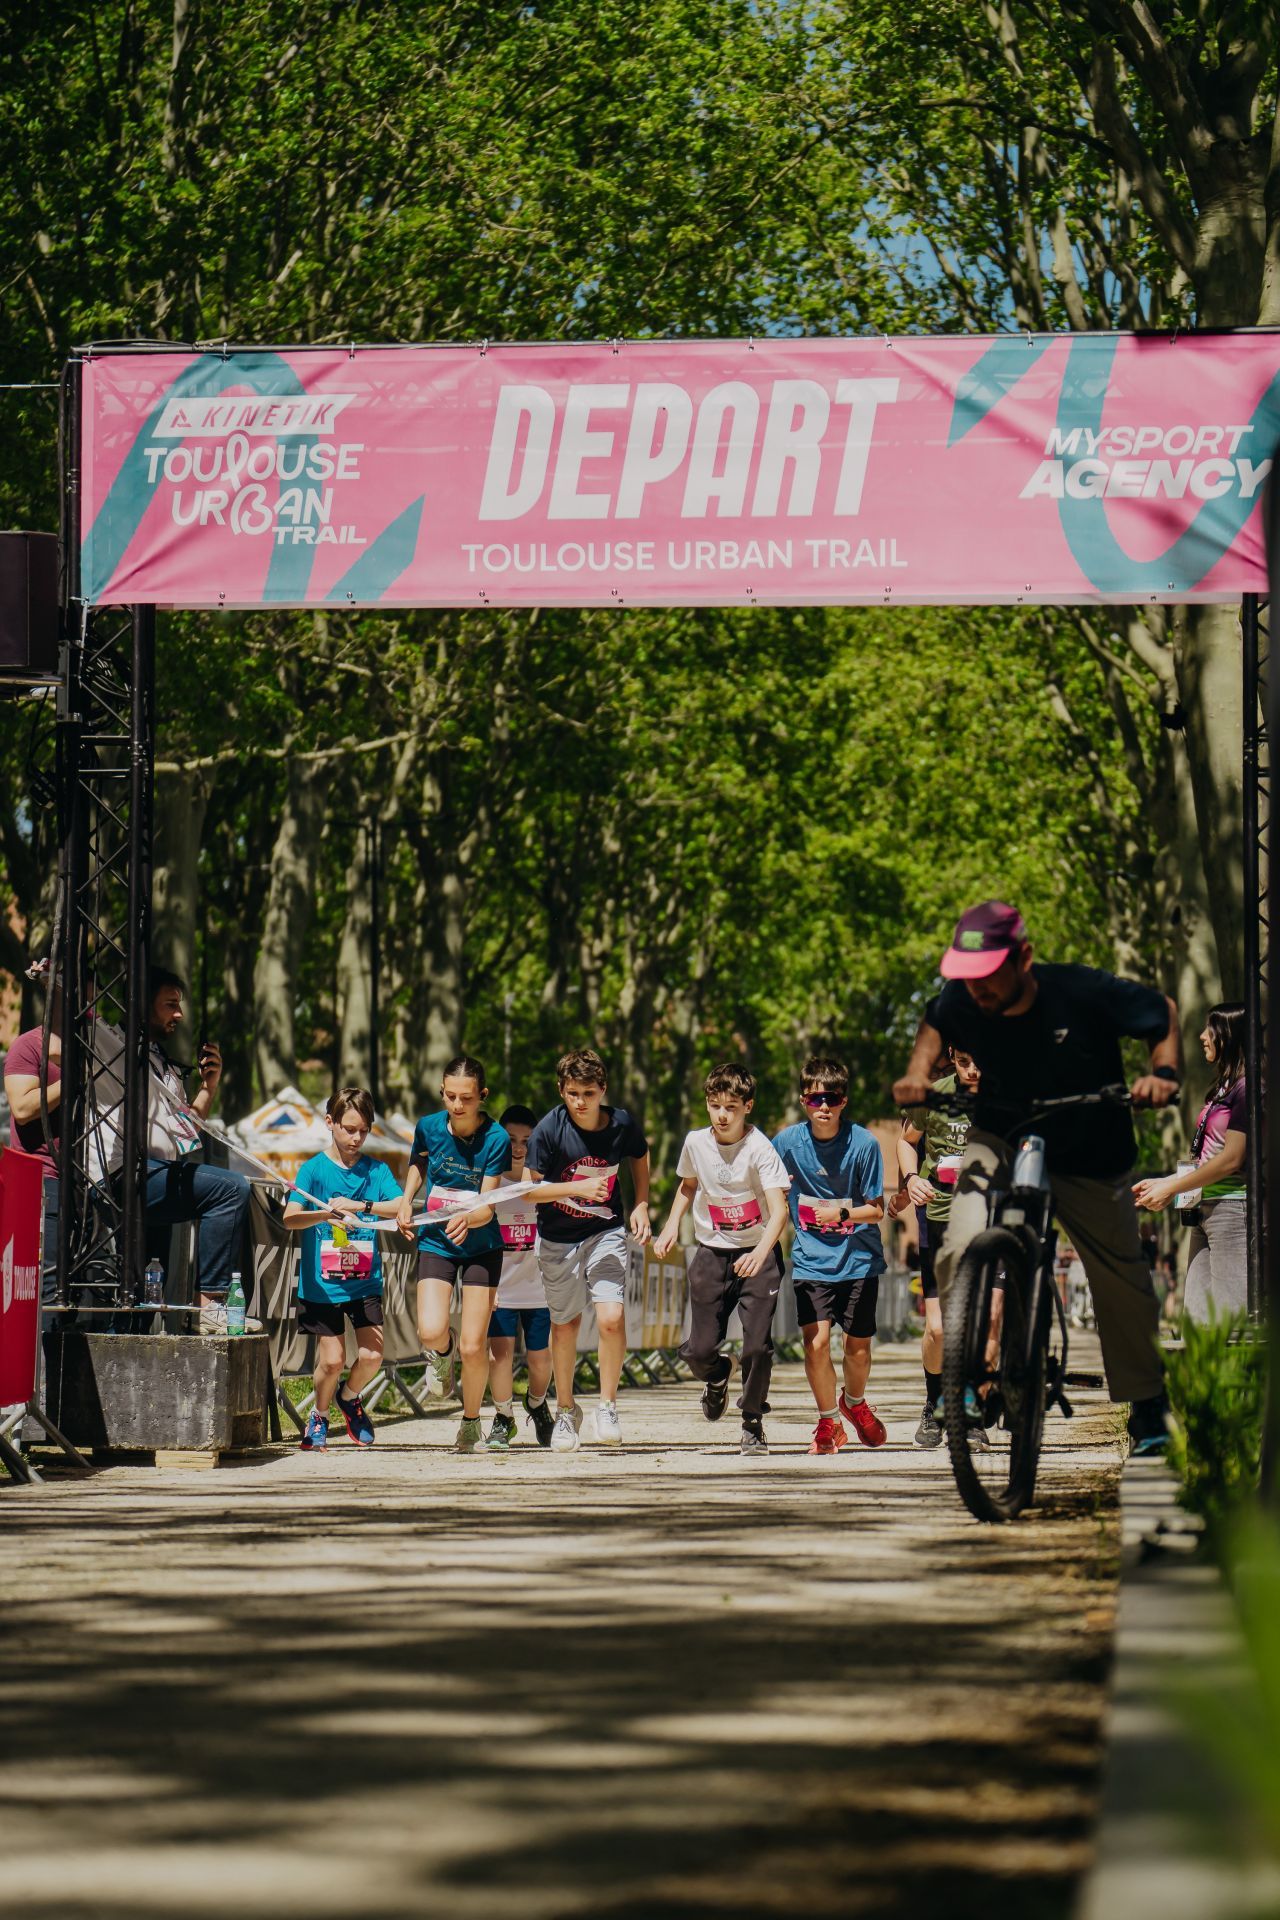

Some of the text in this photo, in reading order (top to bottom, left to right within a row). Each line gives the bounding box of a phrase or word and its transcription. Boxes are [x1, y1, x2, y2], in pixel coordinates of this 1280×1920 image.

[201, 402, 335, 427] KINETIK
[478, 377, 901, 521] DEPART
[1044, 425, 1254, 456] MYSPORT
[143, 433, 366, 491] TOULOUSE
[1018, 458, 1274, 500] AGENCY
[171, 483, 334, 536] URBAN
[271, 525, 367, 545] TRAIL
[461, 538, 909, 573] TOULOUSE URBAN TRAIL
[721, 1206, 745, 1219] 7203
[509, 1225, 532, 1238] 7204
[336, 1253, 360, 1266] 7206
